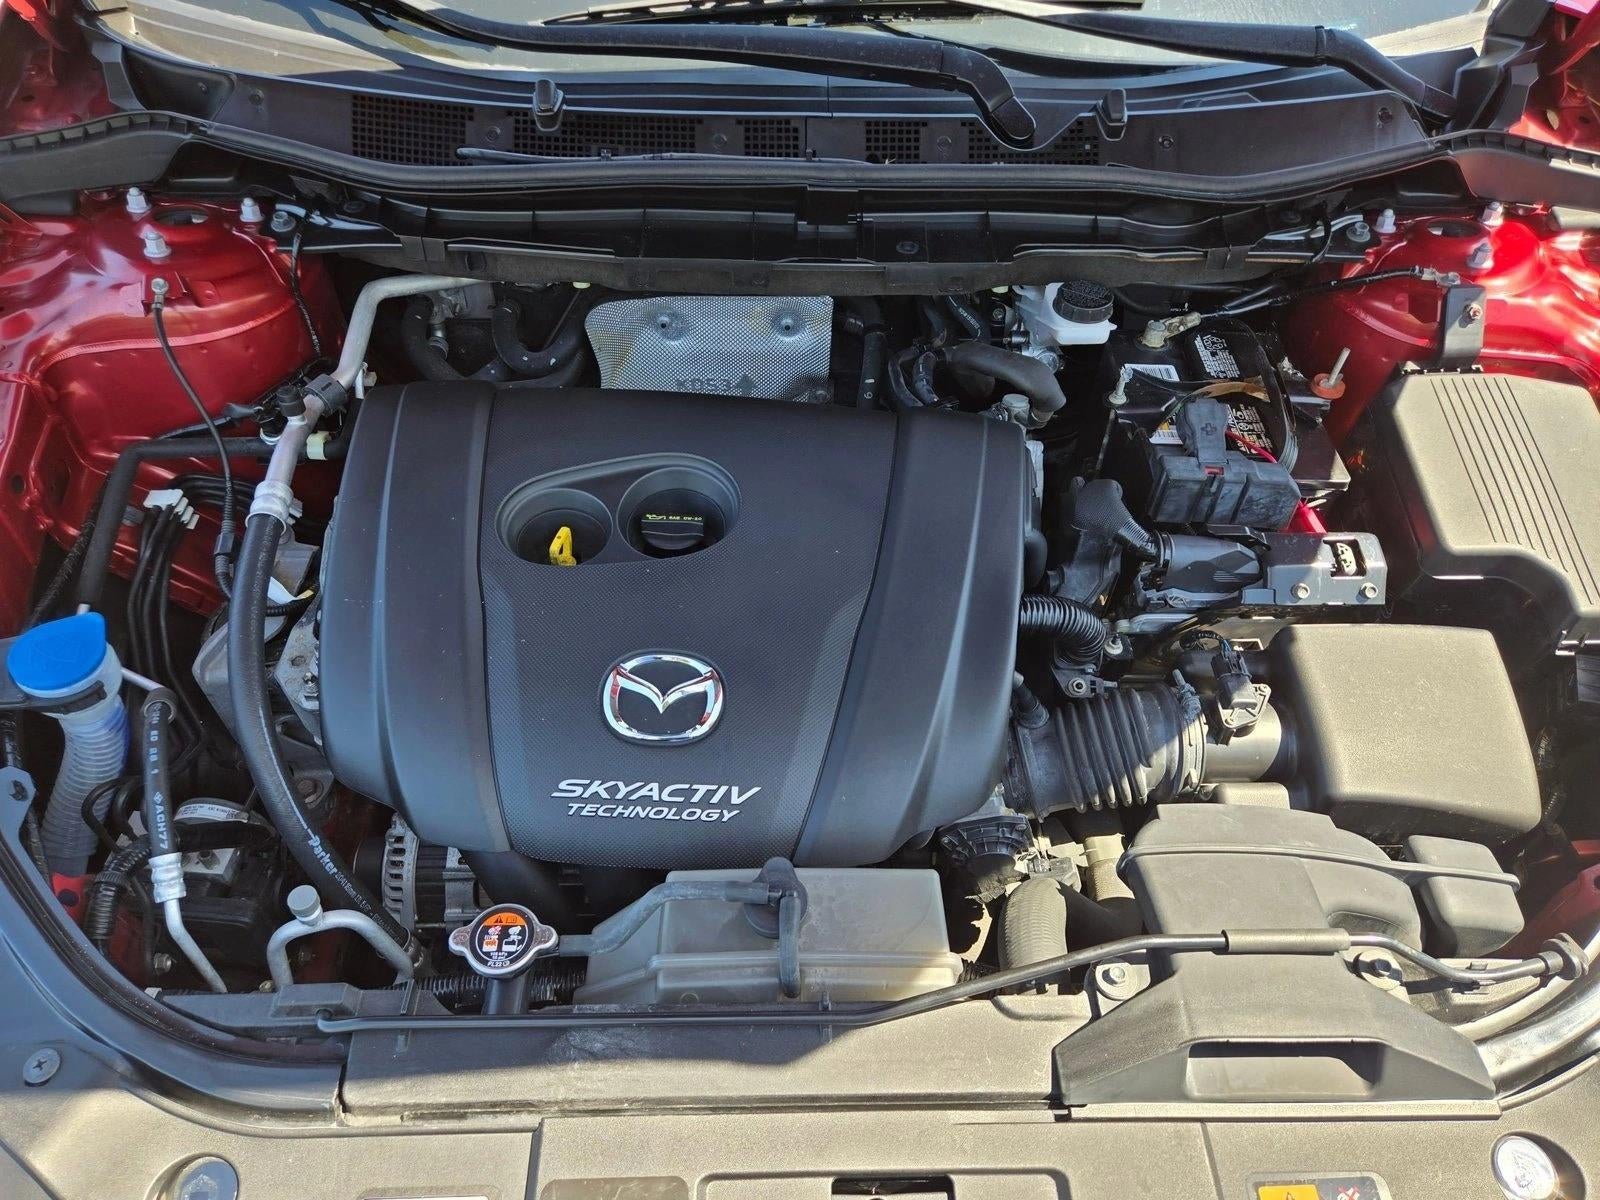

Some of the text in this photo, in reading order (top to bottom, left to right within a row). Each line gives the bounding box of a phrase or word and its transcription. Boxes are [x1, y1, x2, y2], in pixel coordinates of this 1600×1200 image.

[551, 779, 761, 804] SKYACTIV
[568, 803, 740, 822] TECHNOLOGY
[308, 835, 338, 875] Parker
